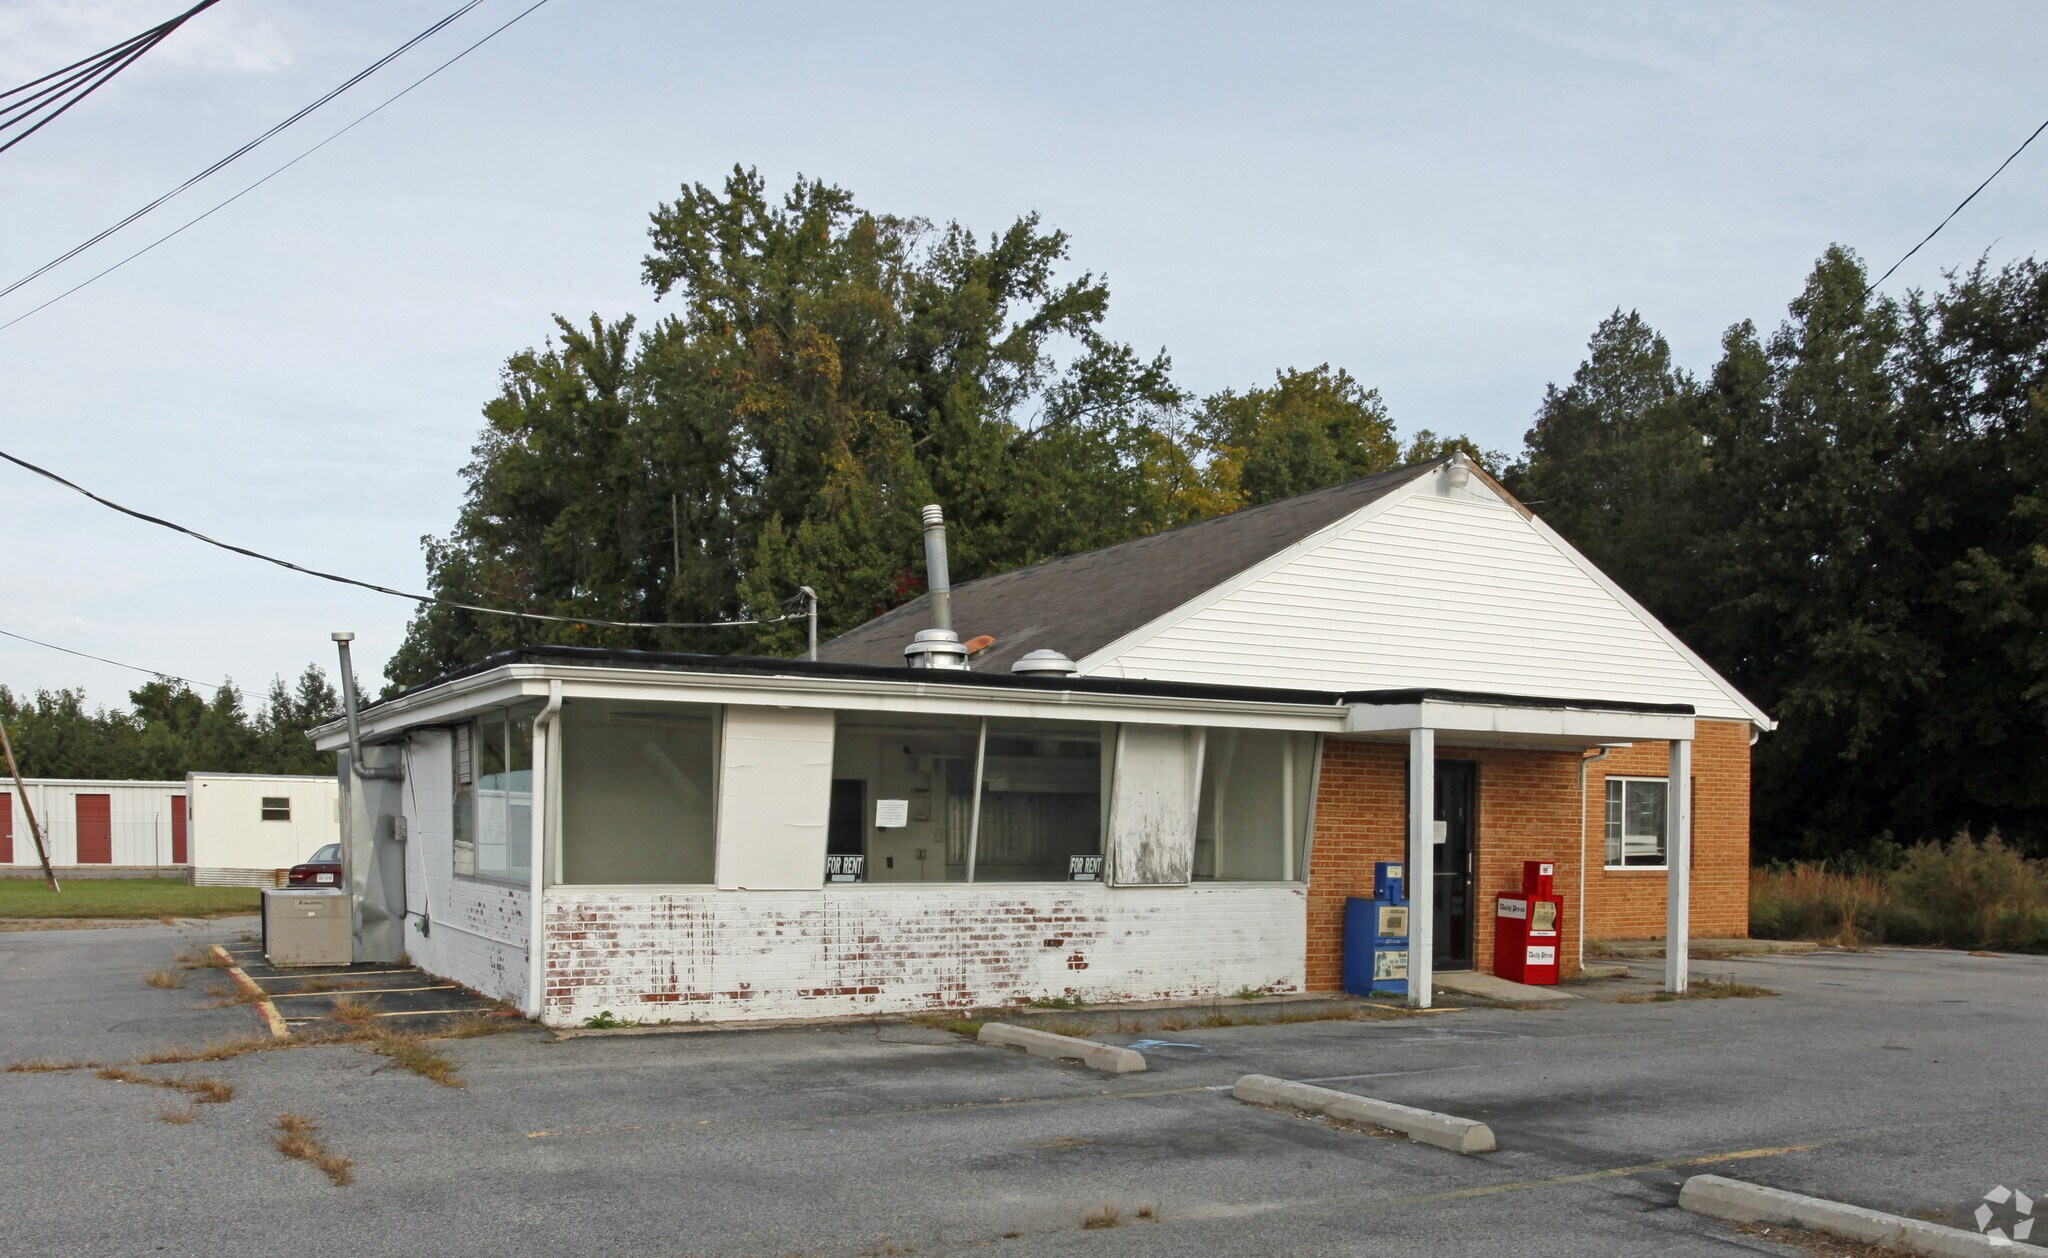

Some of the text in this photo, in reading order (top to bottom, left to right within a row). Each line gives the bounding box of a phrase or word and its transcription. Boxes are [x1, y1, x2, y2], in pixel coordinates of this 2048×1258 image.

[826, 856, 862, 874] FOR RENT
[1070, 857, 1102, 873] FOR RENT
[1500, 903, 1511, 912] Daily
[1529, 951, 1540, 959] Daily
